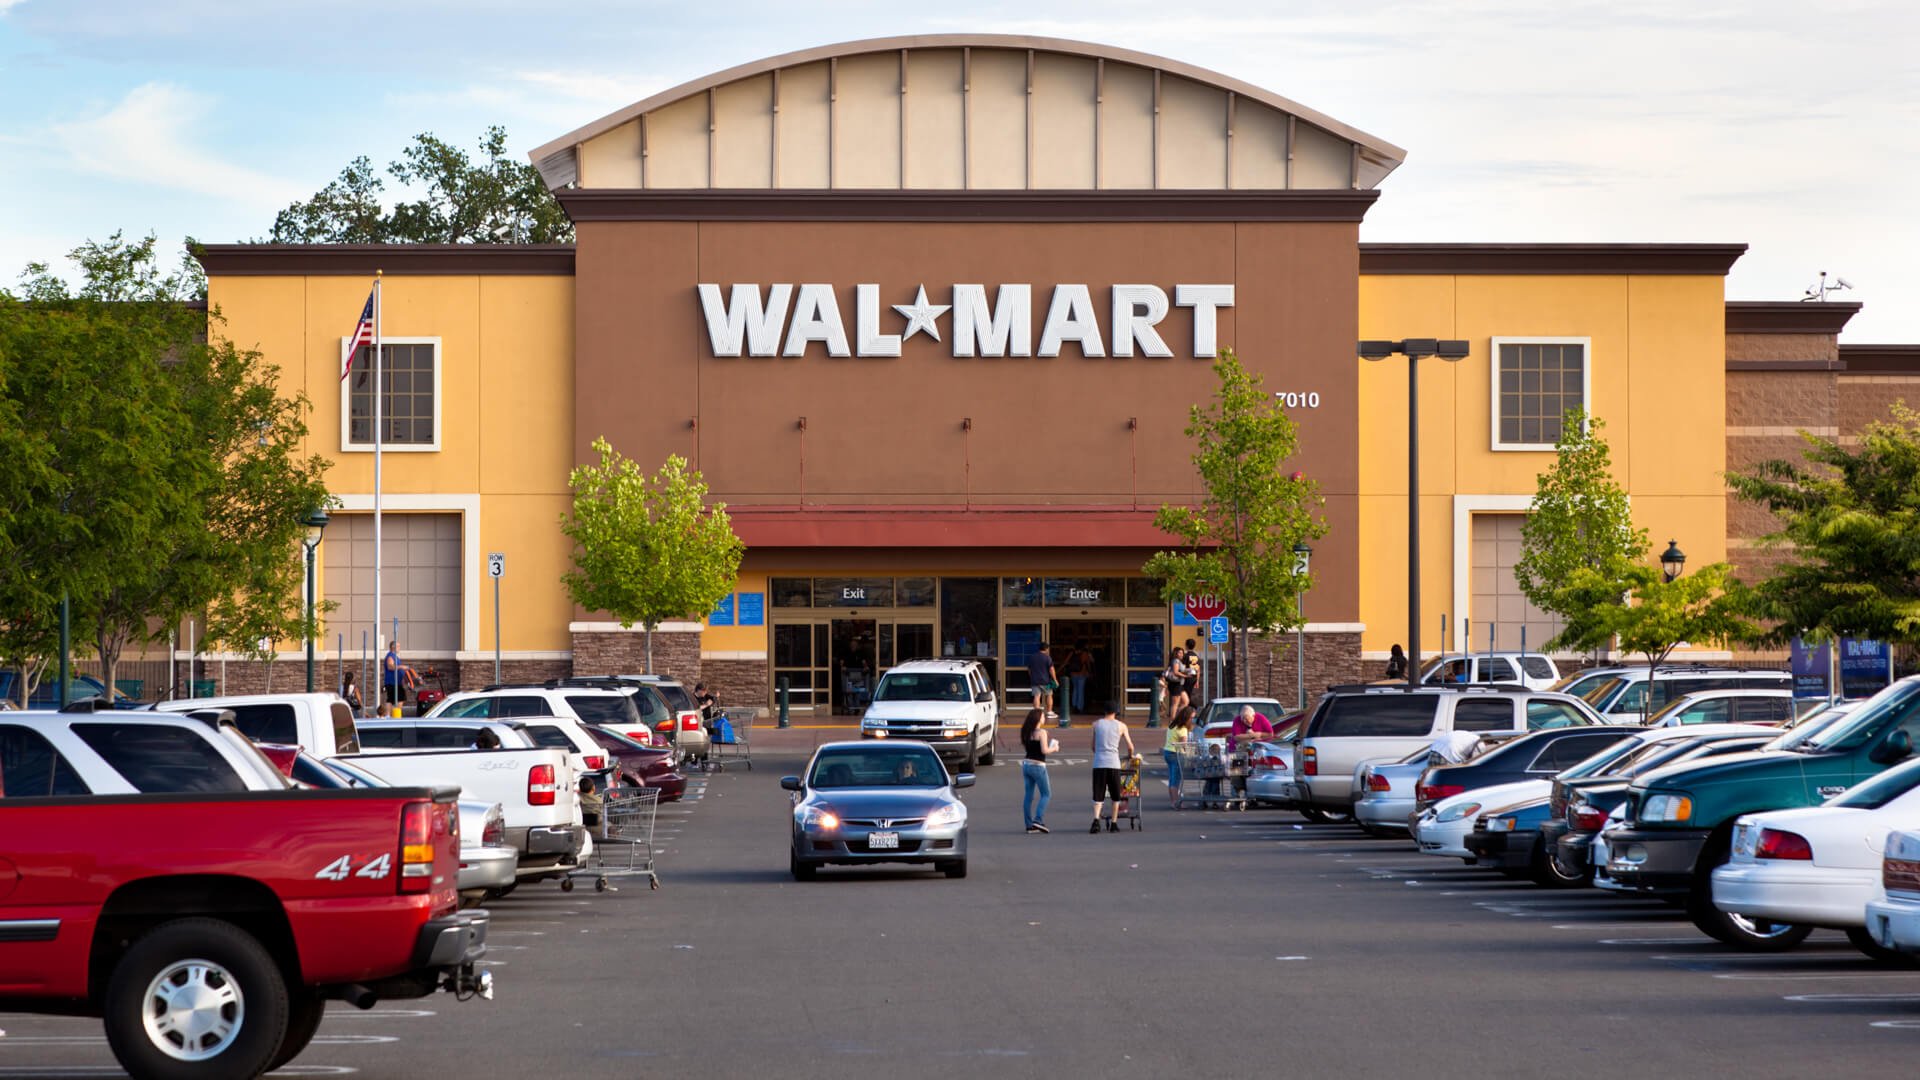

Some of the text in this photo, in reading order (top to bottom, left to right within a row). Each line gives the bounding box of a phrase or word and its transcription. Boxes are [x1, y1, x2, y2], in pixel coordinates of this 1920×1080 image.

[1275, 392, 1319, 408] 7010
[492, 562, 501, 575] 3
[1296, 560, 1306, 573] 2
[843, 587, 865, 599] Exit
[1070, 587, 1100, 599] Enter
